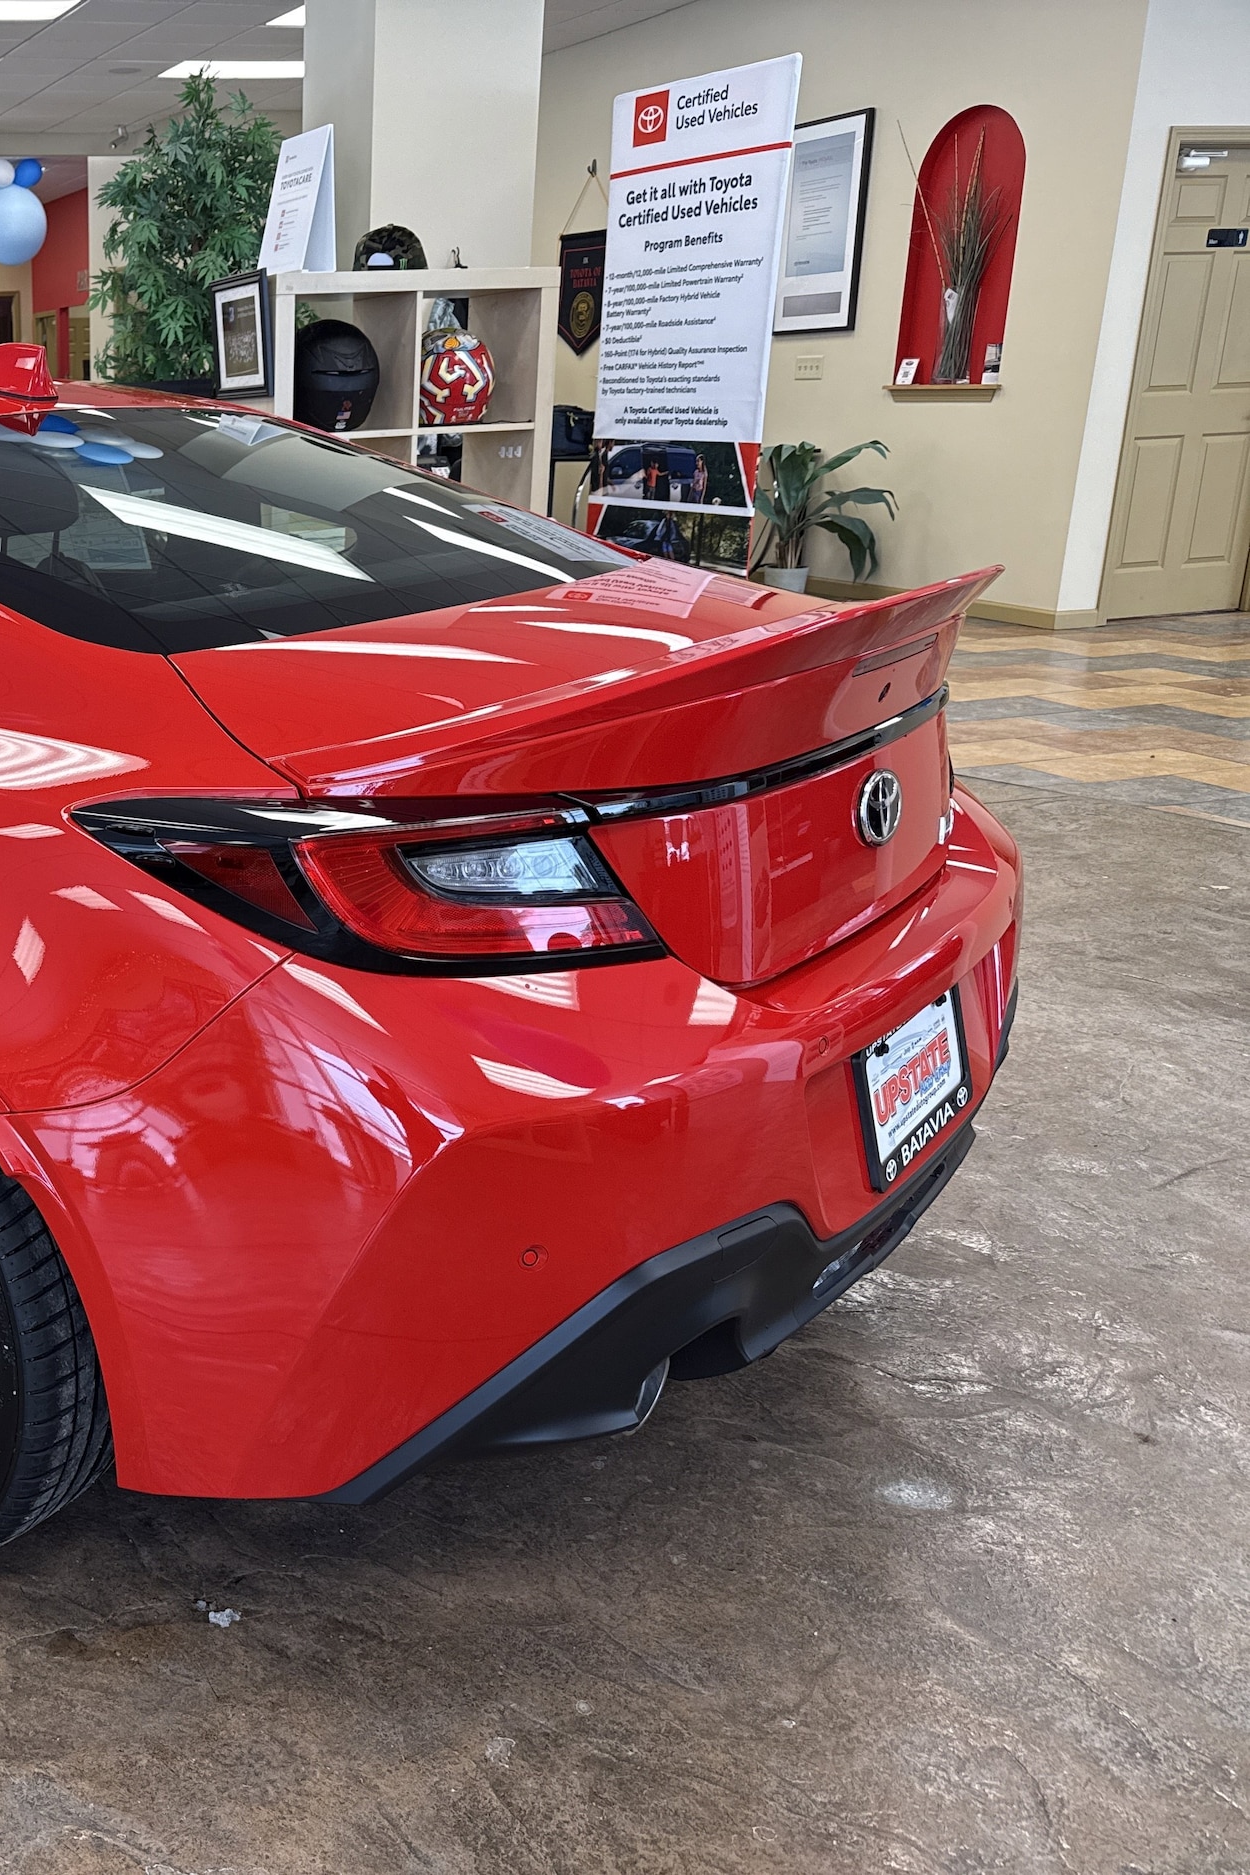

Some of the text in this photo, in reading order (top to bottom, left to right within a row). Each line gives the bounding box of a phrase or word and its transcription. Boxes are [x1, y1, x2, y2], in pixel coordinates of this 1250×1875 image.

[677, 84, 729, 110] Certified
[676, 102, 758, 130] Used Vehicles
[280, 173, 312, 191] TOYOTACARE
[626, 172, 752, 205] Get it all with Toyota
[618, 195, 758, 228] Certified Used Vehicles
[644, 232, 723, 252] Program Benefits
[609, 266, 666, 280] 12-month/12,000-mile
[667, 264, 687, 274] Limited
[689, 261, 733, 272] Comprehensive
[661, 279, 681, 288] Limited
[683, 276, 713, 286] Powertrain
[659, 295, 679, 303] Factory
[680, 292, 699, 302] Hybrid
[700, 290, 720, 299] Vehicle
[658, 319, 683, 327] Roadside
[668, 347, 687, 356] Quality
[688, 346, 716, 354] Assurance
[717, 344, 747, 355] Inspection
[658, 361, 677, 370] History
[602, 376, 639, 384] Reconditioned
[668, 375, 691, 384] exacting
[692, 374, 721, 382] standards
[601, 387, 608, 396] by
[609, 387, 625, 396] Toyota
[626, 386, 665, 395] factory-trained
[624, 406, 719, 415] A Toyota Certified Used Vehicle is
[614, 417, 627, 426] only
[660, 418, 674, 426] your
[675, 417, 694, 427] Toyota
[695, 417, 728, 428] dealership
[873, 1027, 951, 1126] UPSTATE
[901, 1102, 955, 1167] BATAVIA
